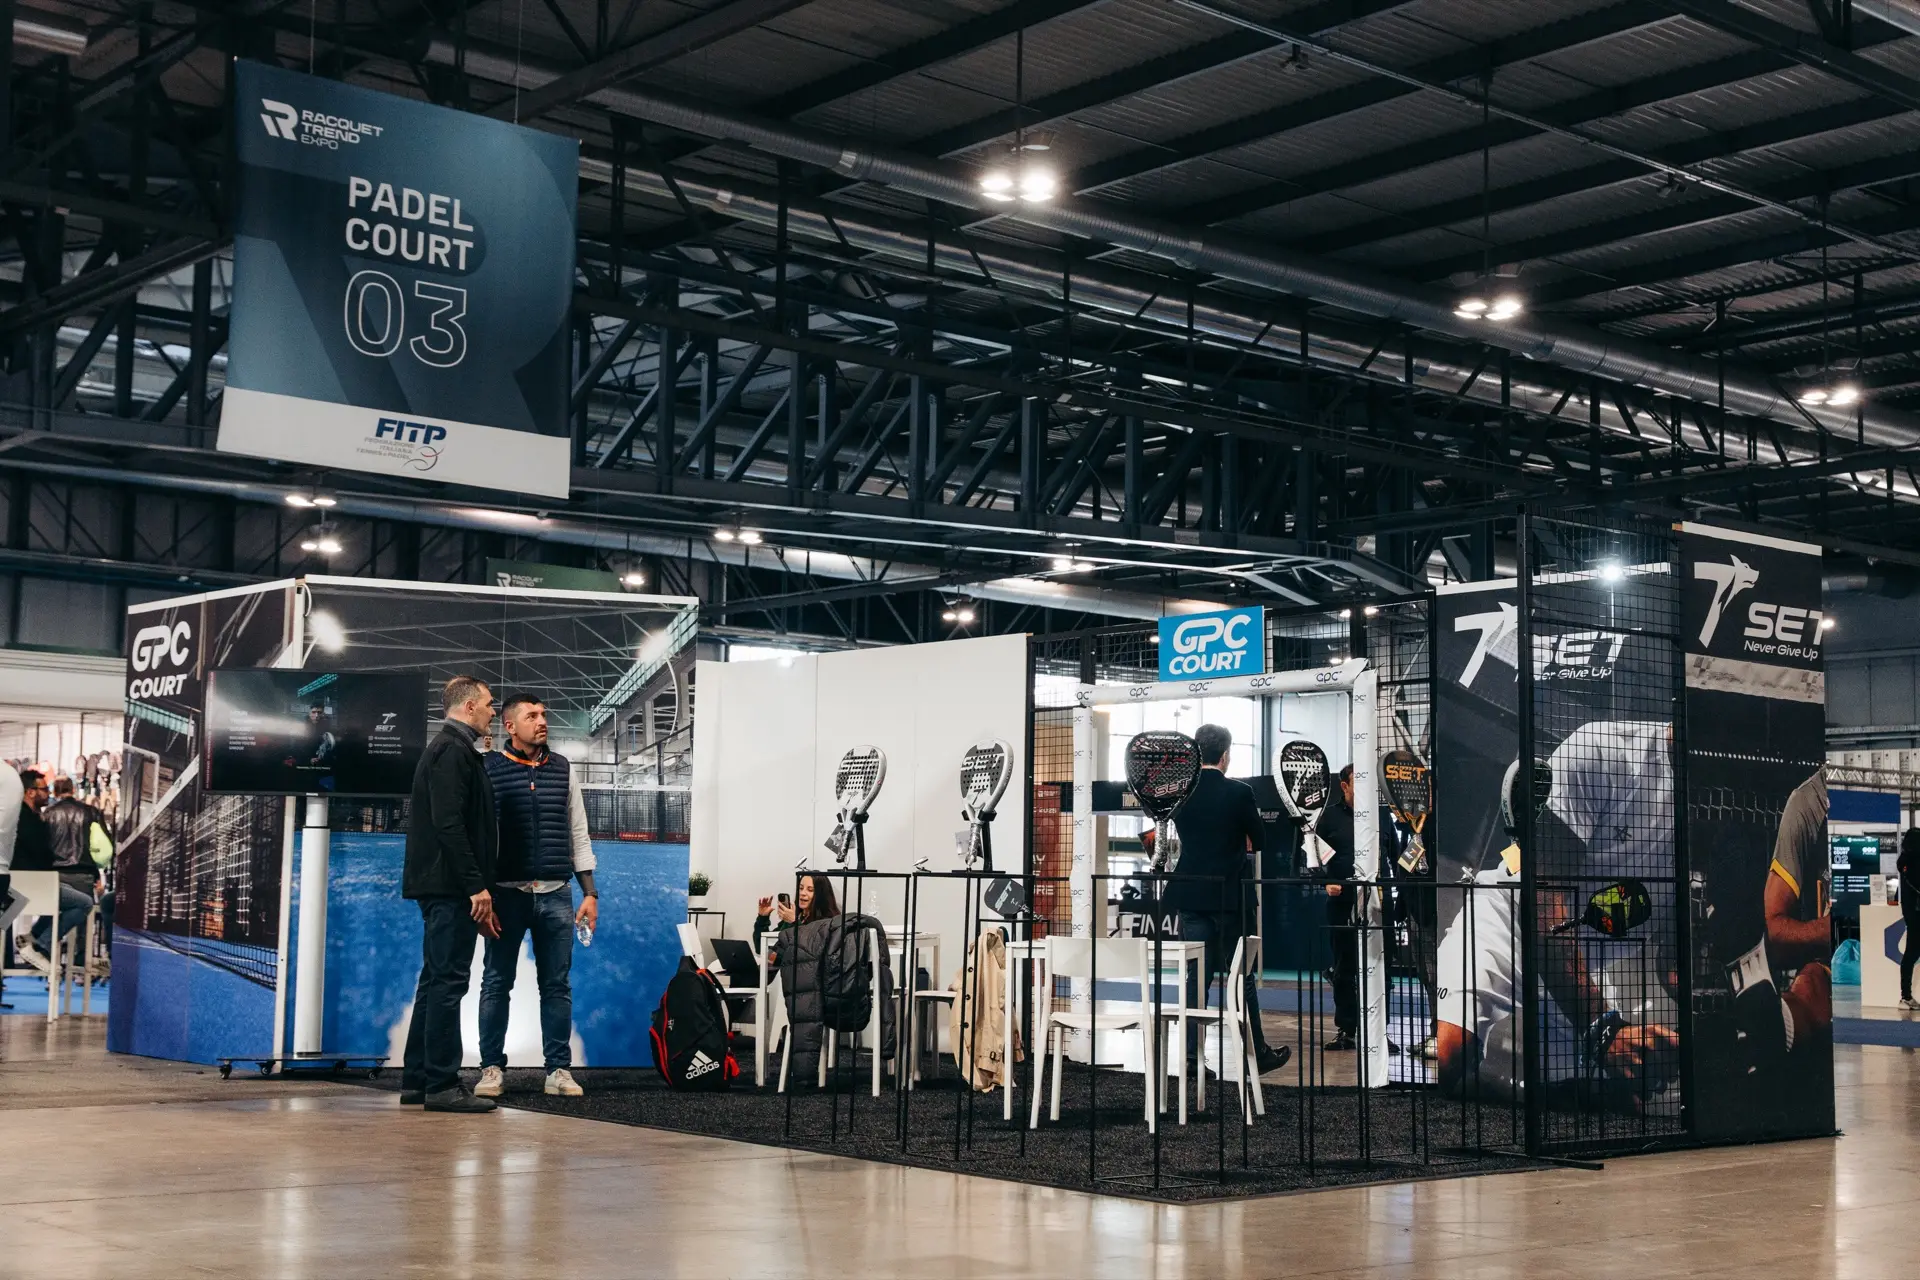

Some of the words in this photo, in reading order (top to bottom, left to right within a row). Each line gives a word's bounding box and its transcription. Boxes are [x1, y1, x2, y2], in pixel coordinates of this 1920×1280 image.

[301, 121, 361, 144] TREND
[302, 109, 384, 137] RACQUET
[301, 133, 339, 150] EXPO
[348, 176, 475, 232] PADEL
[345, 217, 475, 271] COURT
[344, 269, 468, 368] 03
[375, 417, 447, 445] FITP
[1172, 614, 1252, 655] GPC
[1743, 601, 1823, 646] SET
[132, 621, 191, 672] GPC
[1743, 640, 1777, 655] Never
[1777, 644, 1802, 657] Give
[1802, 647, 1819, 661] Up
[1168, 650, 1247, 676] COURT
[129, 674, 188, 700] COURT
[960, 752, 1005, 771] SET
[1386, 763, 1427, 782] SET
[1154, 777, 1192, 798] SET
[1304, 787, 1328, 807] SET
[685, 1060, 720, 1080] adidas
